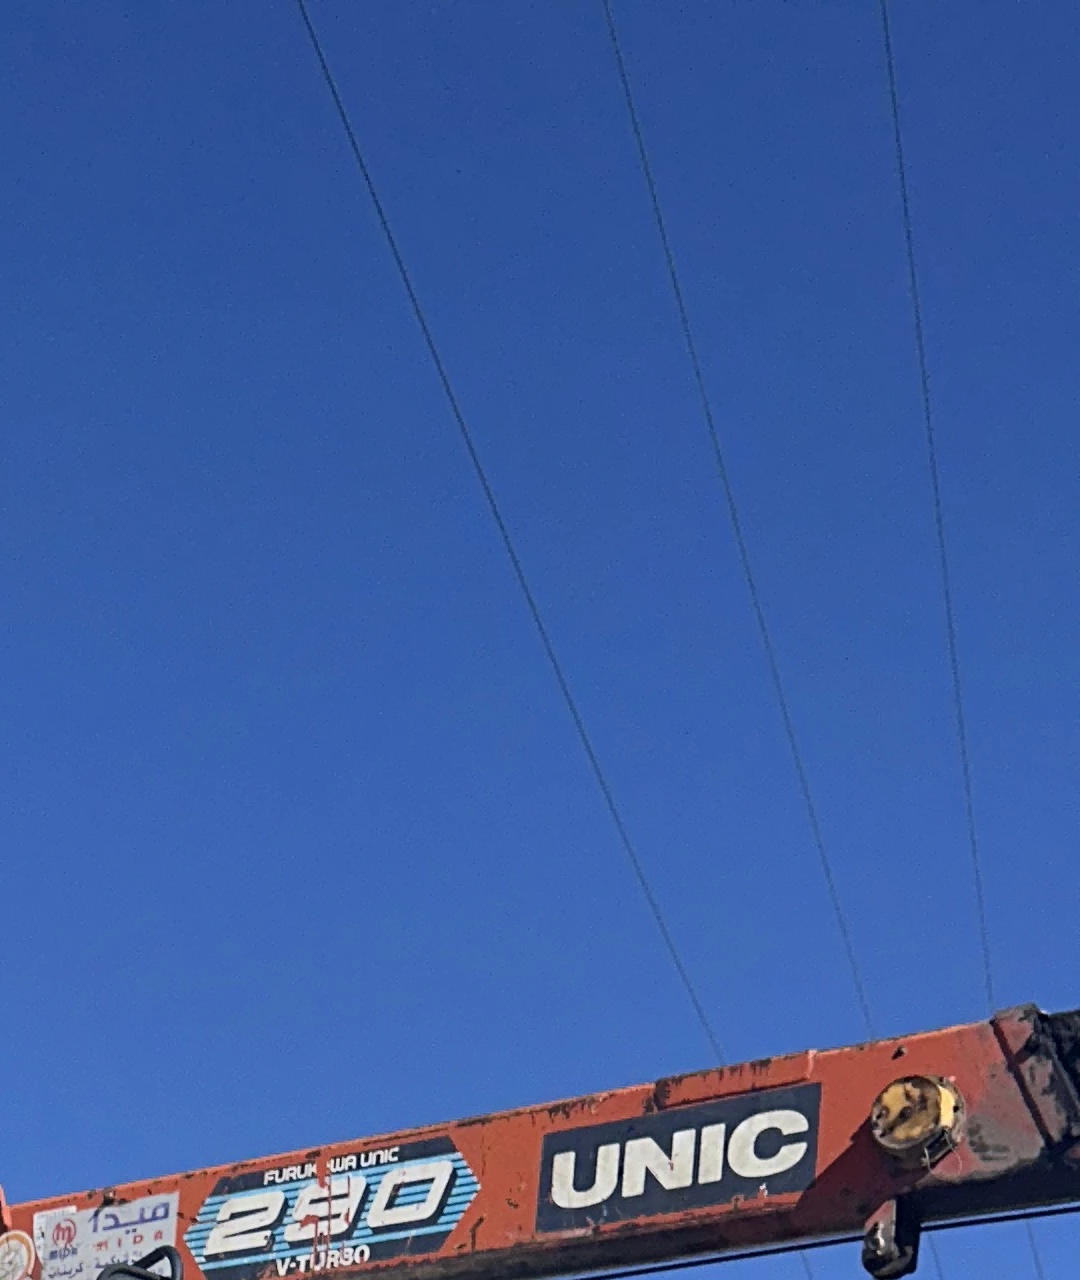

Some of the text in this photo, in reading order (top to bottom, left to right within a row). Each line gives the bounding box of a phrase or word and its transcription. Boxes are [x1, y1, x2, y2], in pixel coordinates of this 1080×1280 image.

[263, 1146, 399, 1186] FURUKWA UNIC
[551, 1109, 809, 1209] UNIC
